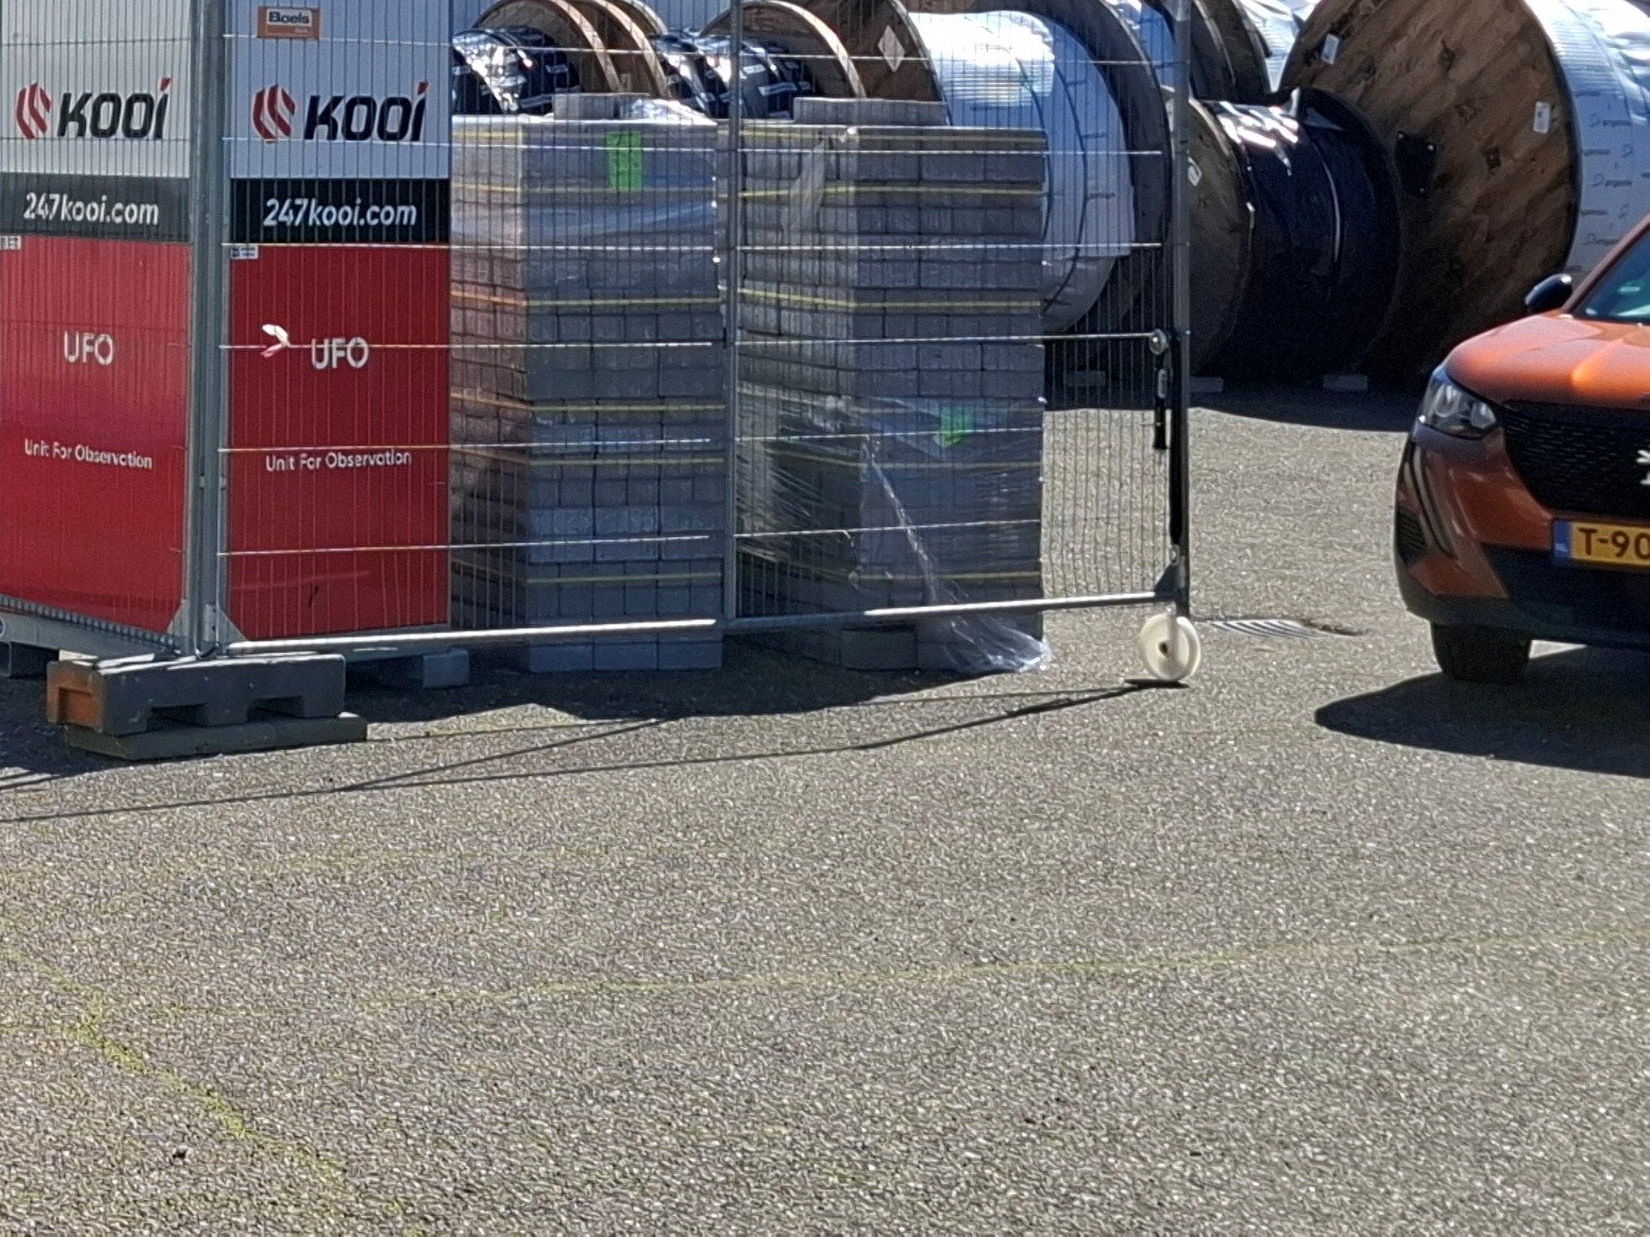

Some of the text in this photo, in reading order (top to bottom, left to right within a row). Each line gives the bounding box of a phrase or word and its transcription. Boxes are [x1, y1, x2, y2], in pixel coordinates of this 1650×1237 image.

[269, 11, 310, 24] Boels
[23, 192, 159, 226] 247kooi.com
[263, 198, 417, 227] 247kooi.com
[63, 330, 114, 365] UFO
[311, 336, 369, 369] UFO
[24, 438, 153, 469] Unit For Observation
[265, 449, 412, 473] Unit For Observation
